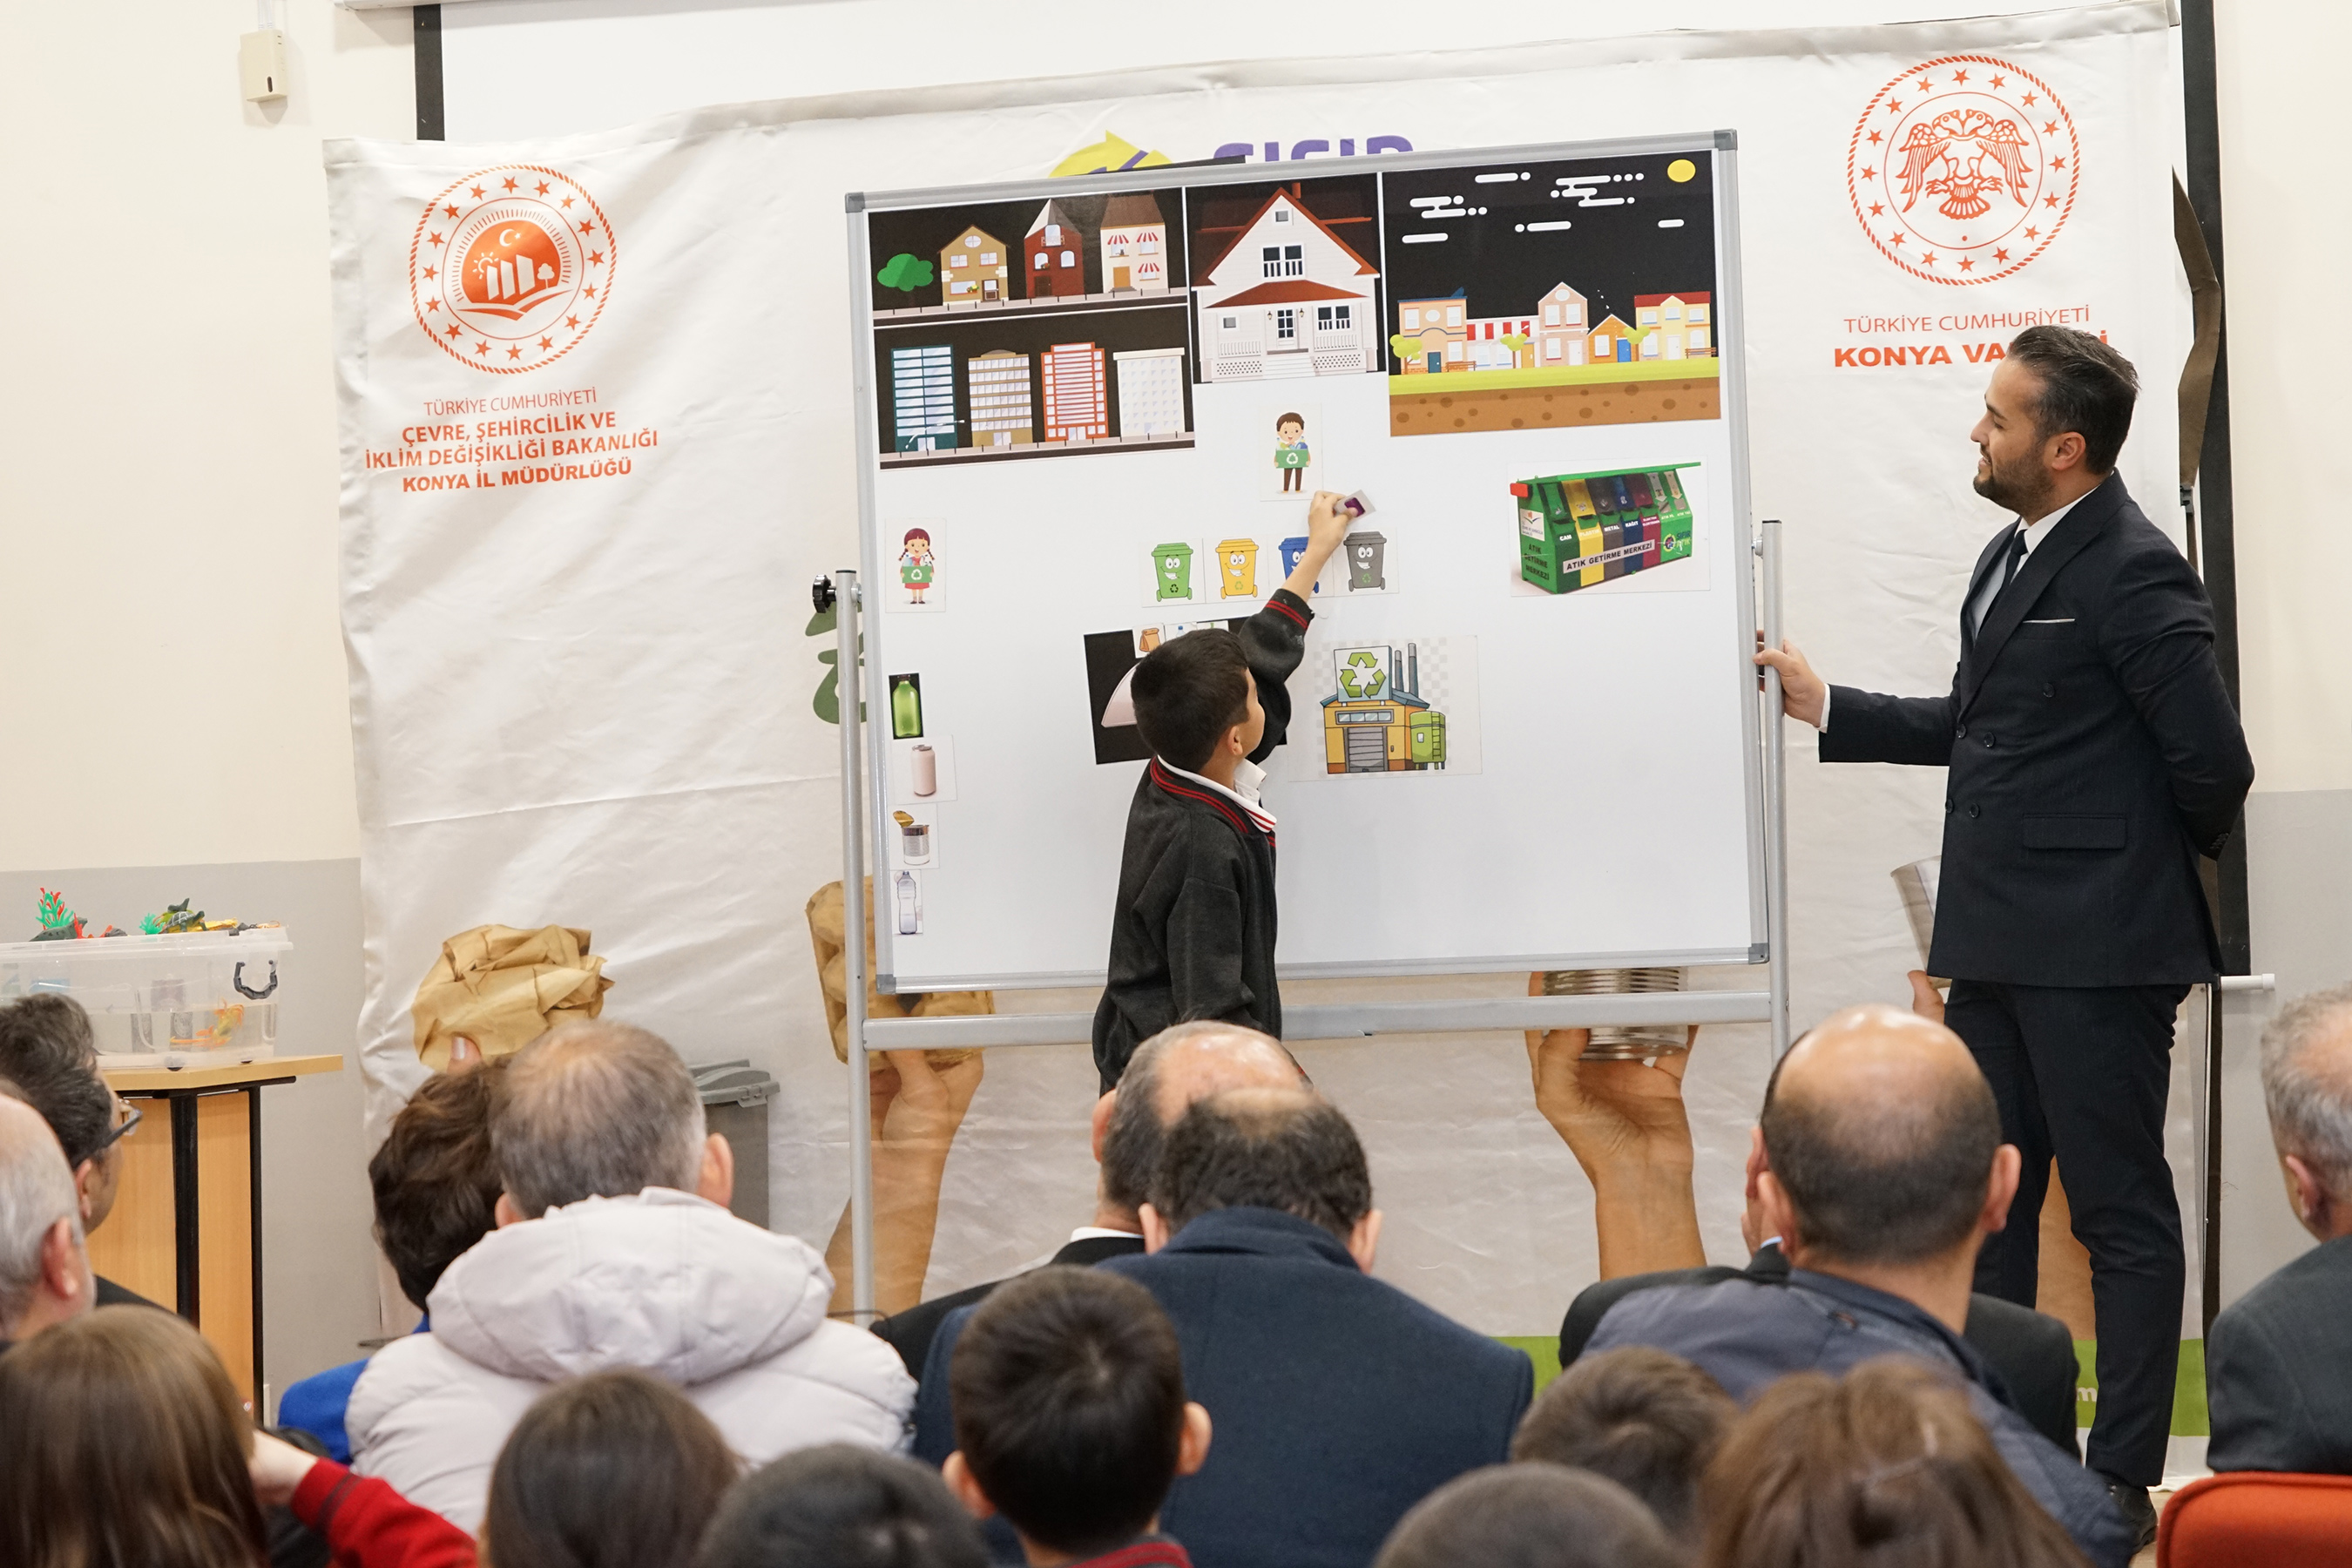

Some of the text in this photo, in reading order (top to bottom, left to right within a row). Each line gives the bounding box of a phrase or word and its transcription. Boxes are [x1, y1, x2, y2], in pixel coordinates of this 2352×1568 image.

[1843, 305, 2090, 334] TÜRKİYE CUMHURİYETİ
[1834, 345, 1953, 368] KONYA
[423, 386, 598, 417] TÜRKİYE CUMHURİYETİ
[402, 411, 617, 448] ÇEVRE, ŞEHİRCİLİK VE
[365, 428, 659, 469] İKLİM DEĞİŞİKLİĞİ BAKANLIĞI
[402, 457, 632, 493] KONYA İL MÜDÜRLÜĞÜ
[1566, 542, 1652, 571] ATIK GETİRME MERKEZİ
